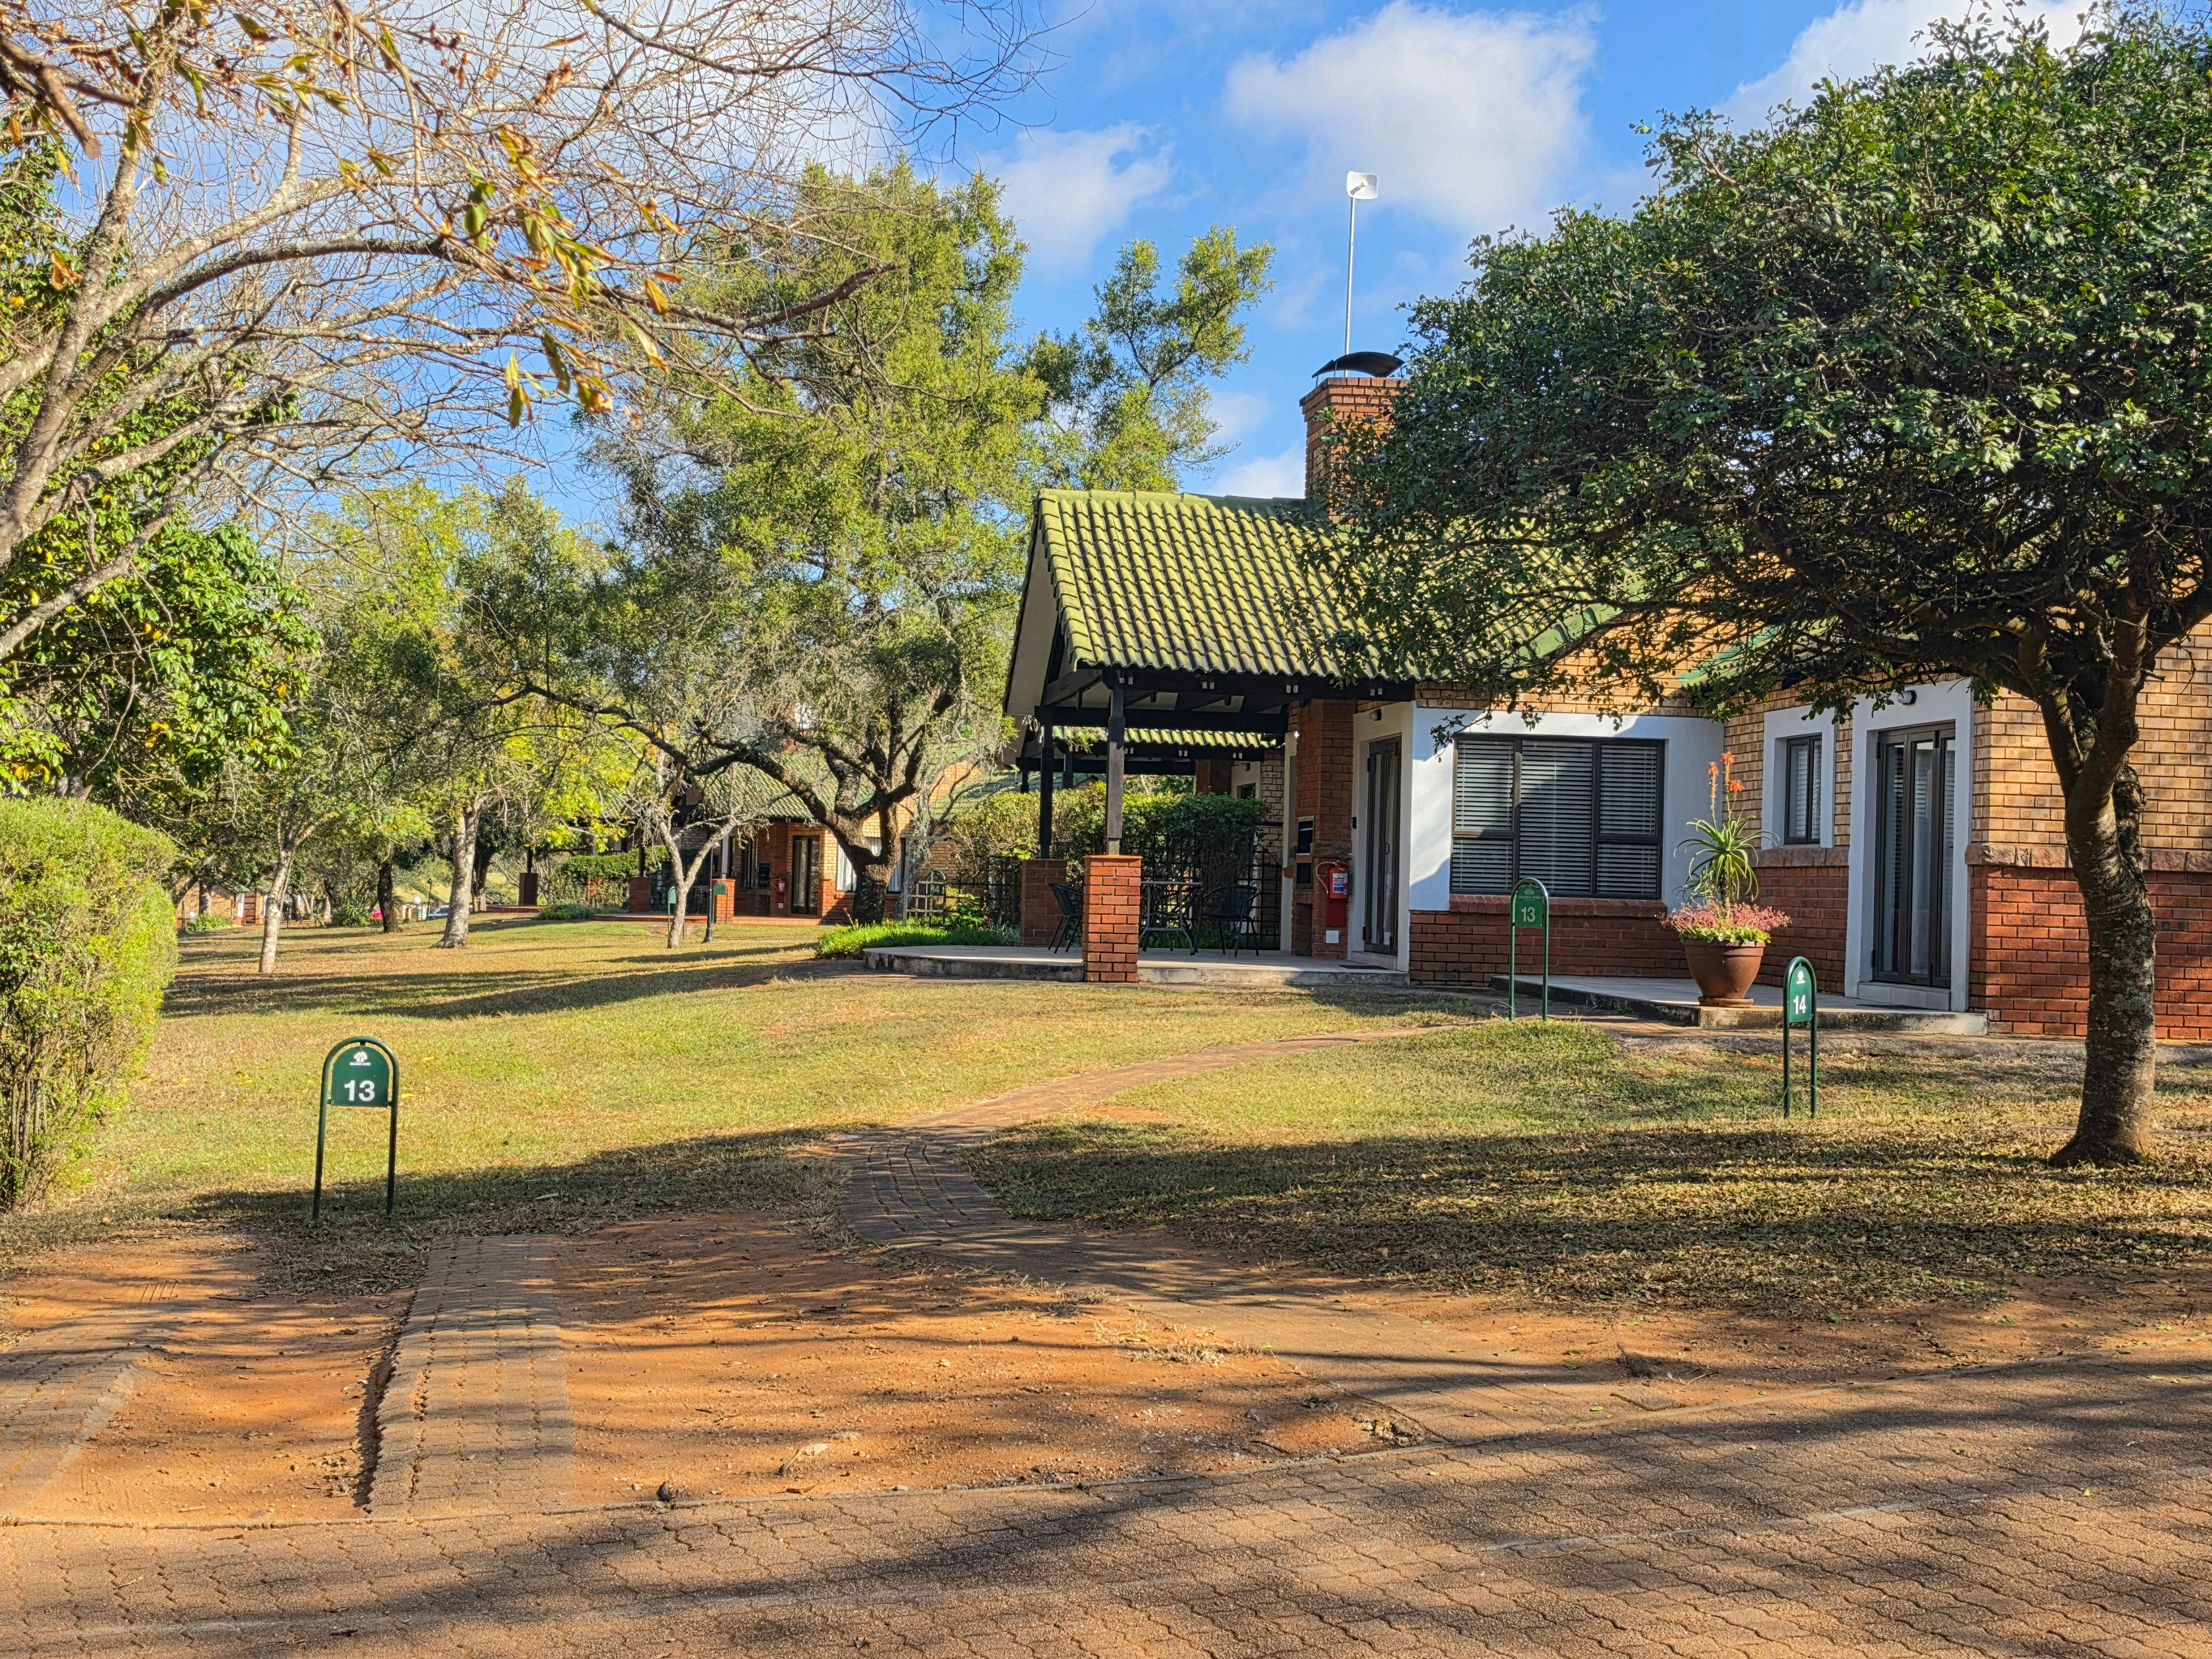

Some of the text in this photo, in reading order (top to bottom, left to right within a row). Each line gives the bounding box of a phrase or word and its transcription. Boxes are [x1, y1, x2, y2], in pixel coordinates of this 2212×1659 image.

[932, 885, 940, 894] 14
[1521, 906, 1536, 922] 13
[1793, 994, 1807, 1015] 14
[344, 1080, 375, 1102] 13
